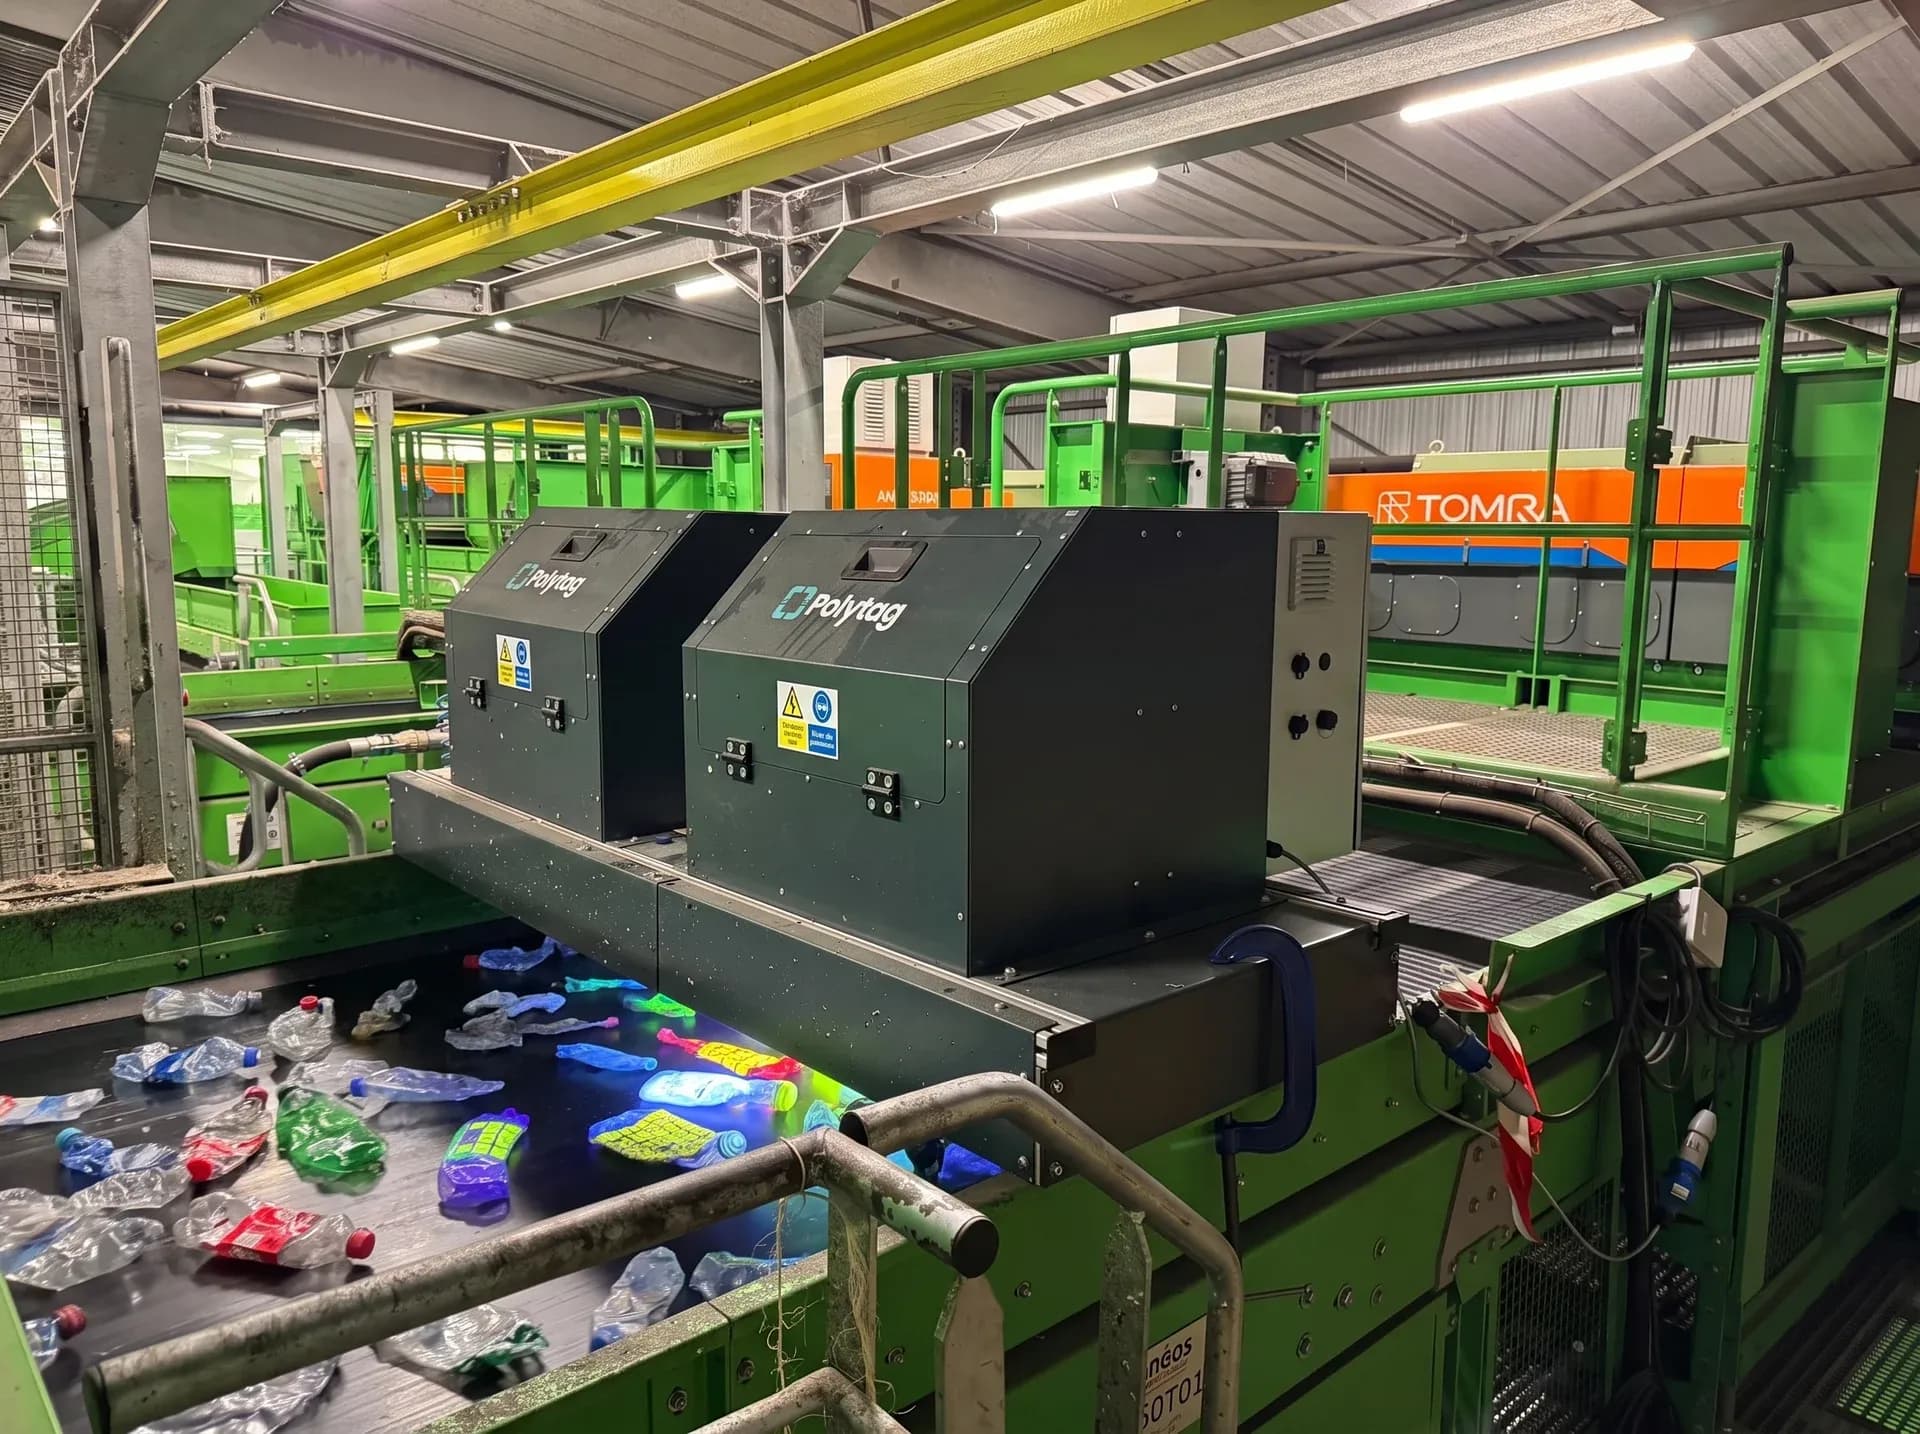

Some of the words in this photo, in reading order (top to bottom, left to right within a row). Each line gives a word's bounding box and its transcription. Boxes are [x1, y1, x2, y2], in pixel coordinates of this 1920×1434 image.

[1416, 493, 1571, 523] TOMRA
[524, 569, 587, 598] Polytag
[804, 593, 908, 632] Polytag
